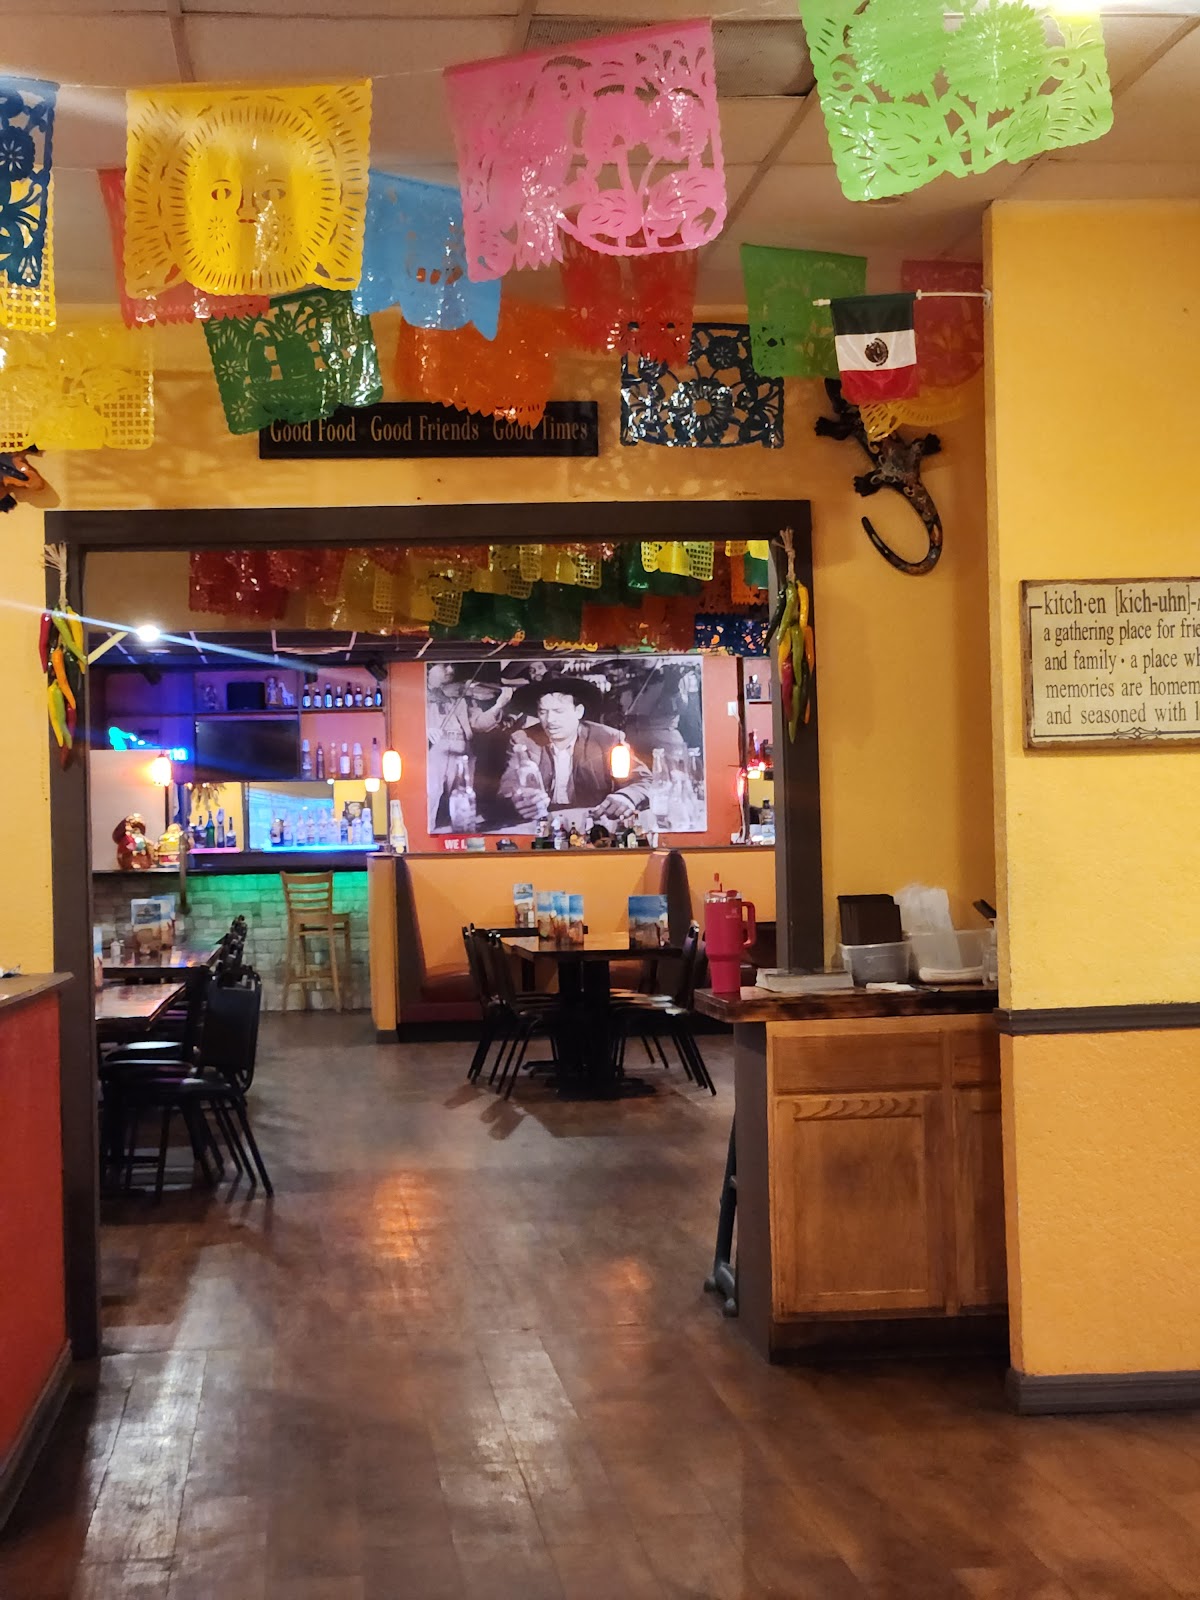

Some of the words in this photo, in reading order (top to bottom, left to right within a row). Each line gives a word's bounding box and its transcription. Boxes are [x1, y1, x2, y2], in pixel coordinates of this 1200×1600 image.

[270, 418, 312, 443] Good
[318, 416, 356, 442] Food
[370, 415, 412, 441] Good
[419, 415, 479, 441] Friends
[542, 415, 588, 441] Times
[1043, 627, 1051, 641] a
[1055, 620, 1114, 647] gathering
[1119, 620, 1152, 646] place
[1157, 618, 1176, 639] for
[1044, 650, 1067, 671] and
[1130, 654, 1138, 668] a
[1143, 648, 1178, 674] place
[1046, 677, 1115, 699] memories
[1121, 681, 1143, 697] are
[1149, 676, 1200, 696] homem
[1046, 704, 1072, 725] and
[1080, 702, 1146, 725] seasoned
[1154, 701, 1187, 722] with
[444, 839, 459, 850] WE
